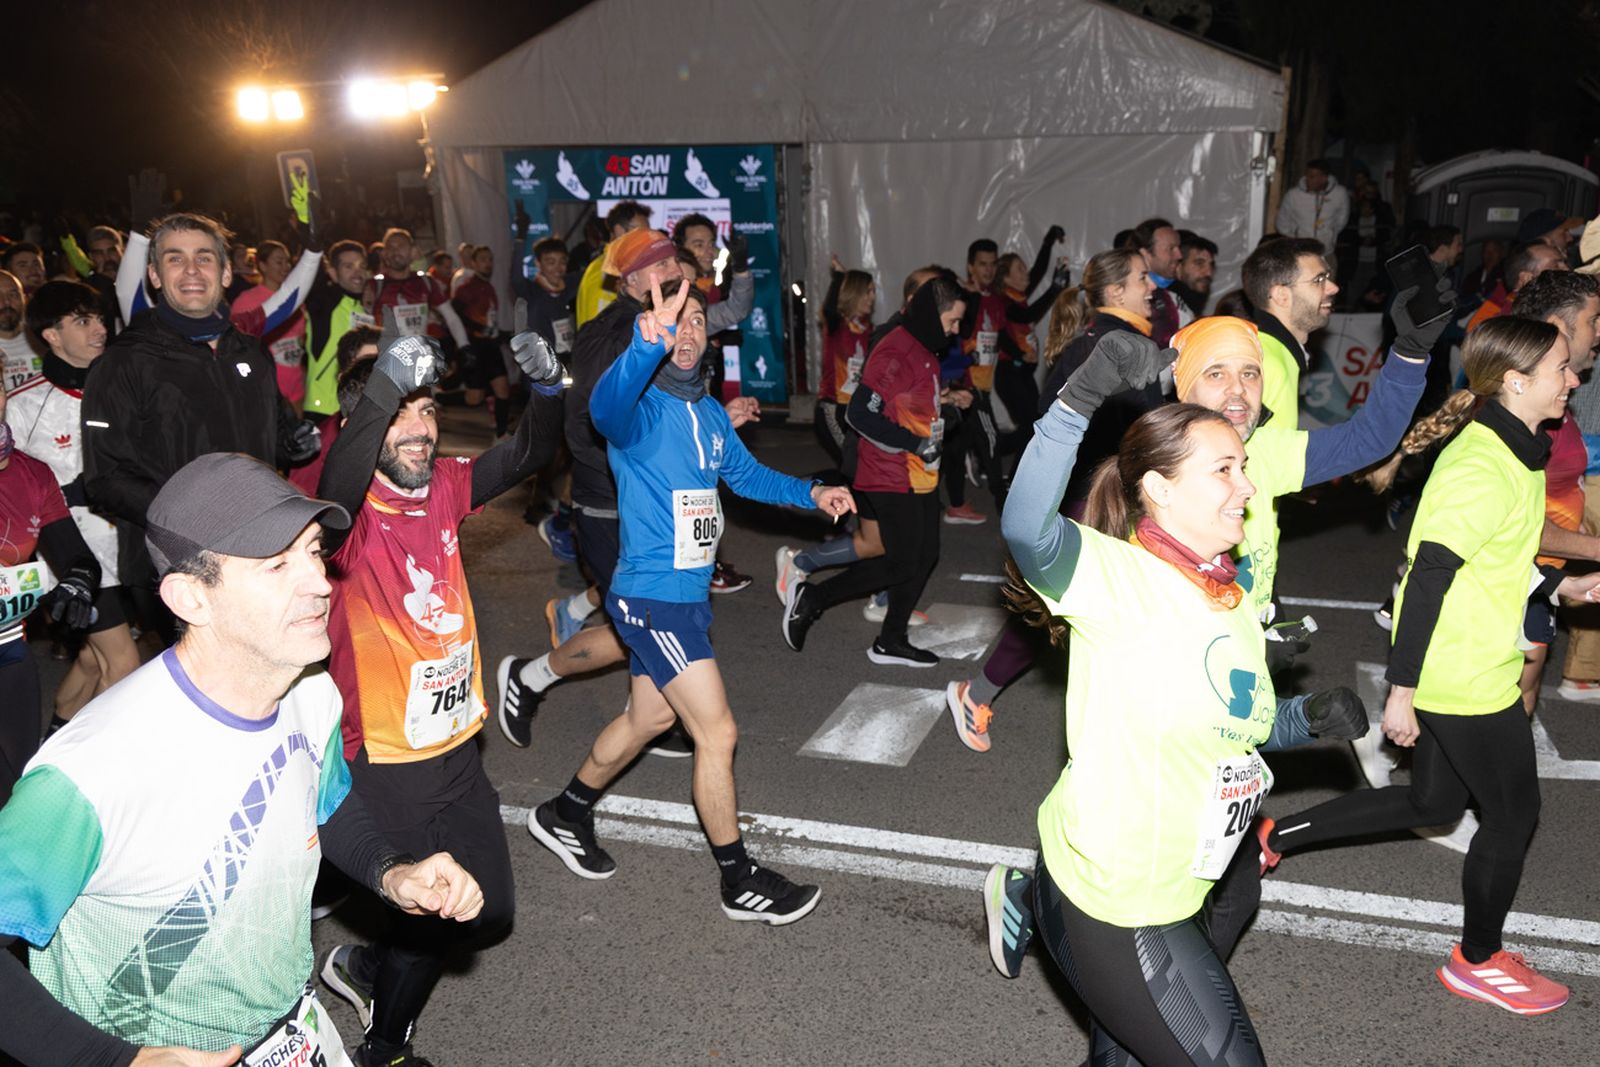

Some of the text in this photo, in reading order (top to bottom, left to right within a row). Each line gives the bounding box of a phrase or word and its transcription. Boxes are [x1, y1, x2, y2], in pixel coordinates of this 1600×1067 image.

[605, 154, 671, 176] 43 SAN
[601, 171, 669, 196] ANTÓN
[693, 516, 717, 541] 806
[422, 680, 443, 690] SAN
[1220, 786, 1242, 801] SAN
